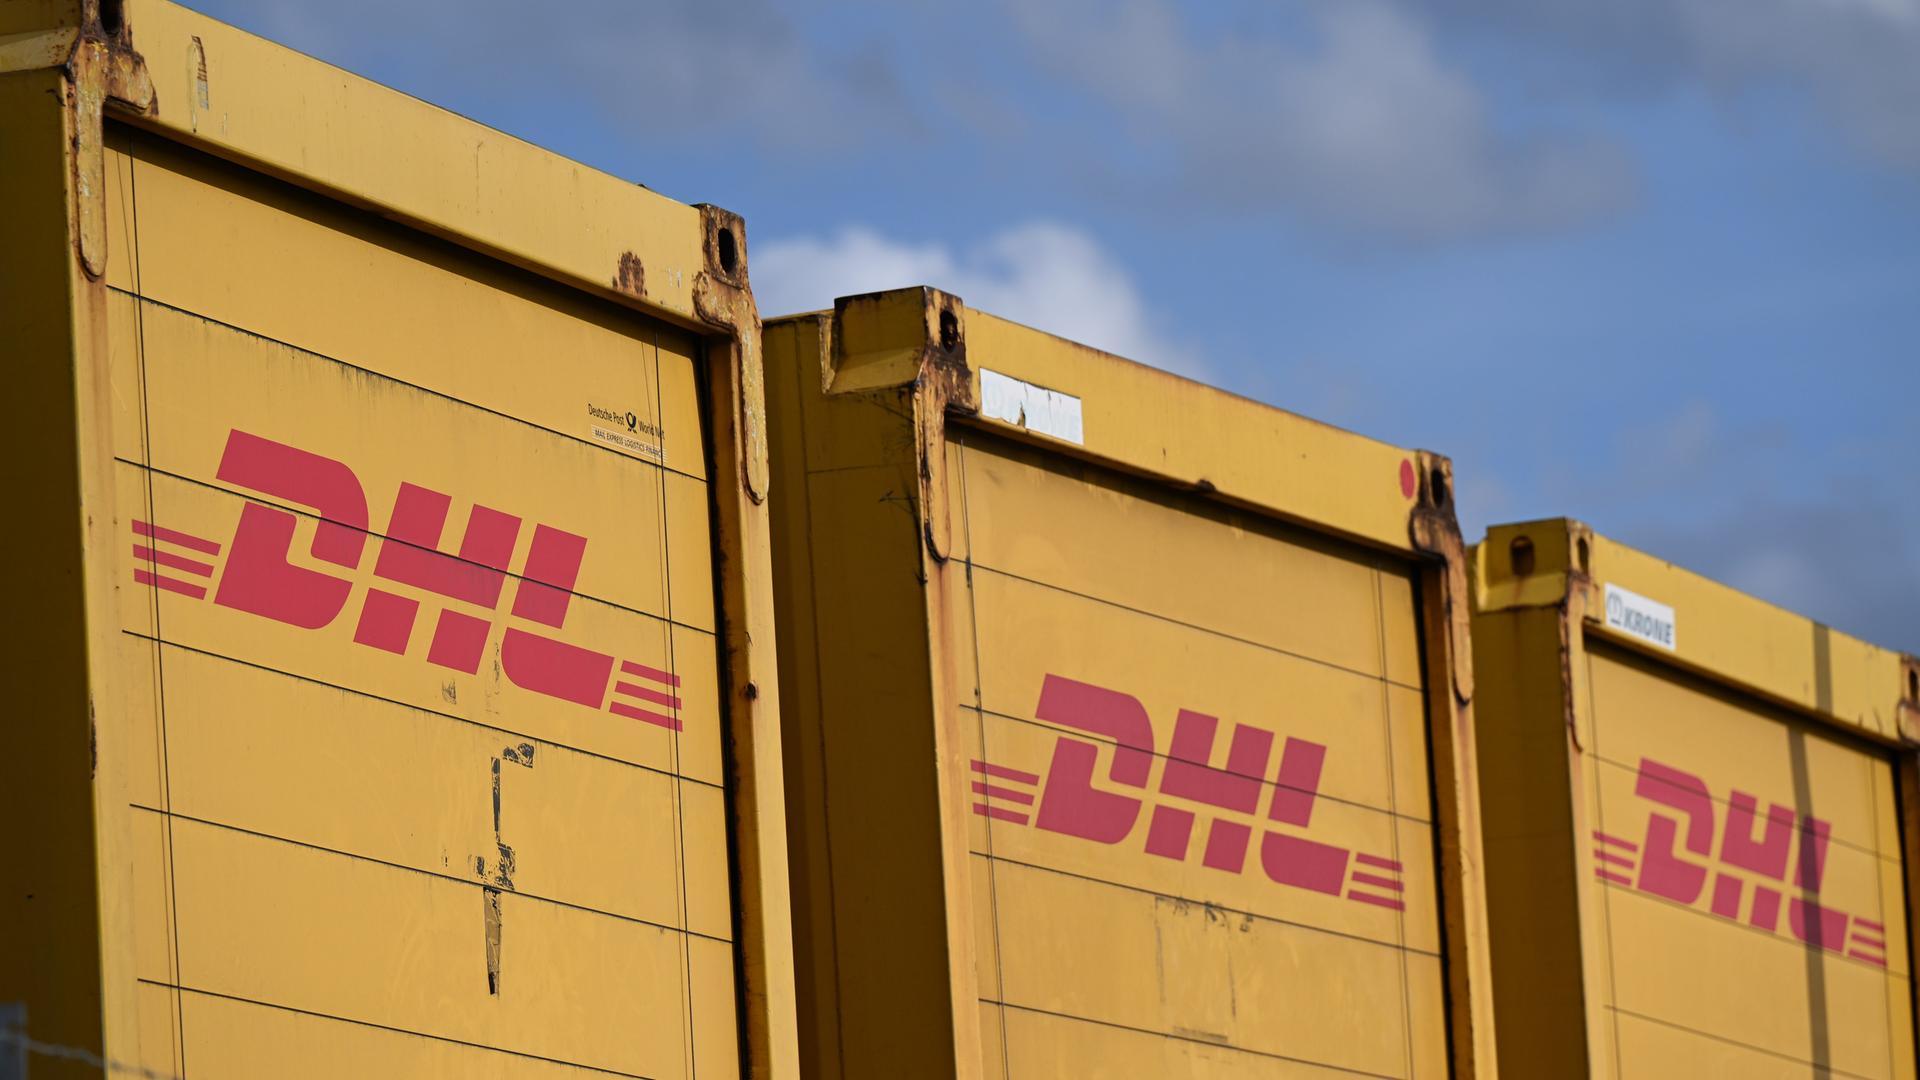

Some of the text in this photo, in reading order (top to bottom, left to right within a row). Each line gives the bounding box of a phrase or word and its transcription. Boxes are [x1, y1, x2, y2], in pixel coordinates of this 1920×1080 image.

[588, 403, 612, 422] Deutsche
[612, 411, 624, 426] Post
[638, 420, 654, 437] World
[216, 430, 613, 708] DHL
[1624, 607, 1671, 645] KRONE
[1035, 673, 1350, 897] DHL
[1635, 757, 1849, 953] DHL
